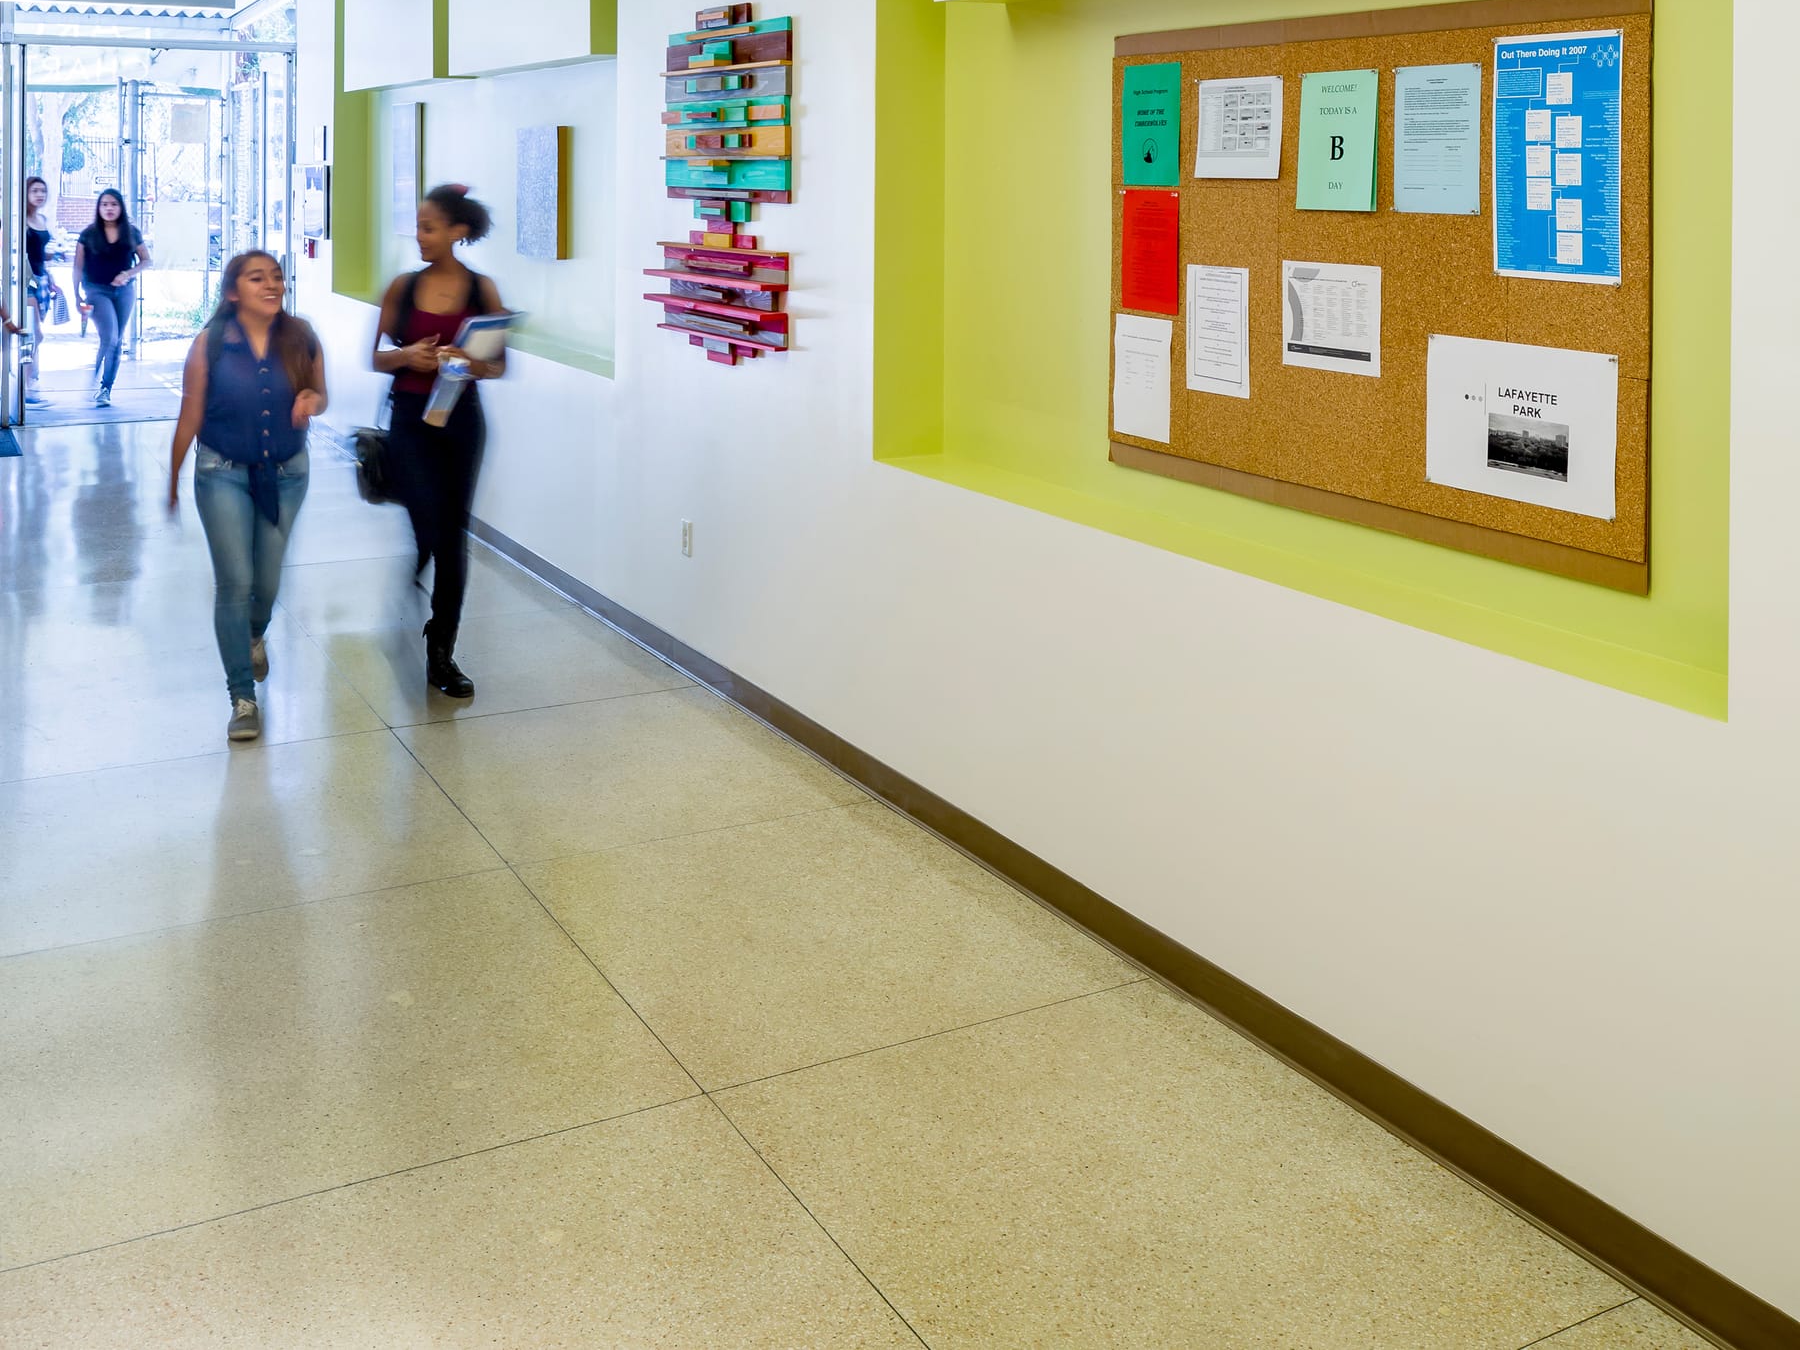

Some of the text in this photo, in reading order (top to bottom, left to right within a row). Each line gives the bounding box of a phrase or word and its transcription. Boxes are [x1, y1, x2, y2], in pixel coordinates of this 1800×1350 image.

[1501, 46, 1587, 60] Out There Doing It 2007
[1321, 84, 1357, 94] WELCOME!
[1320, 106, 1357, 115] TODAY IS A
[1329, 135, 1344, 161] B
[1328, 181, 1343, 190] DAY
[1498, 386, 1558, 406] LAFAYETTE
[1513, 404, 1542, 419] PARK
